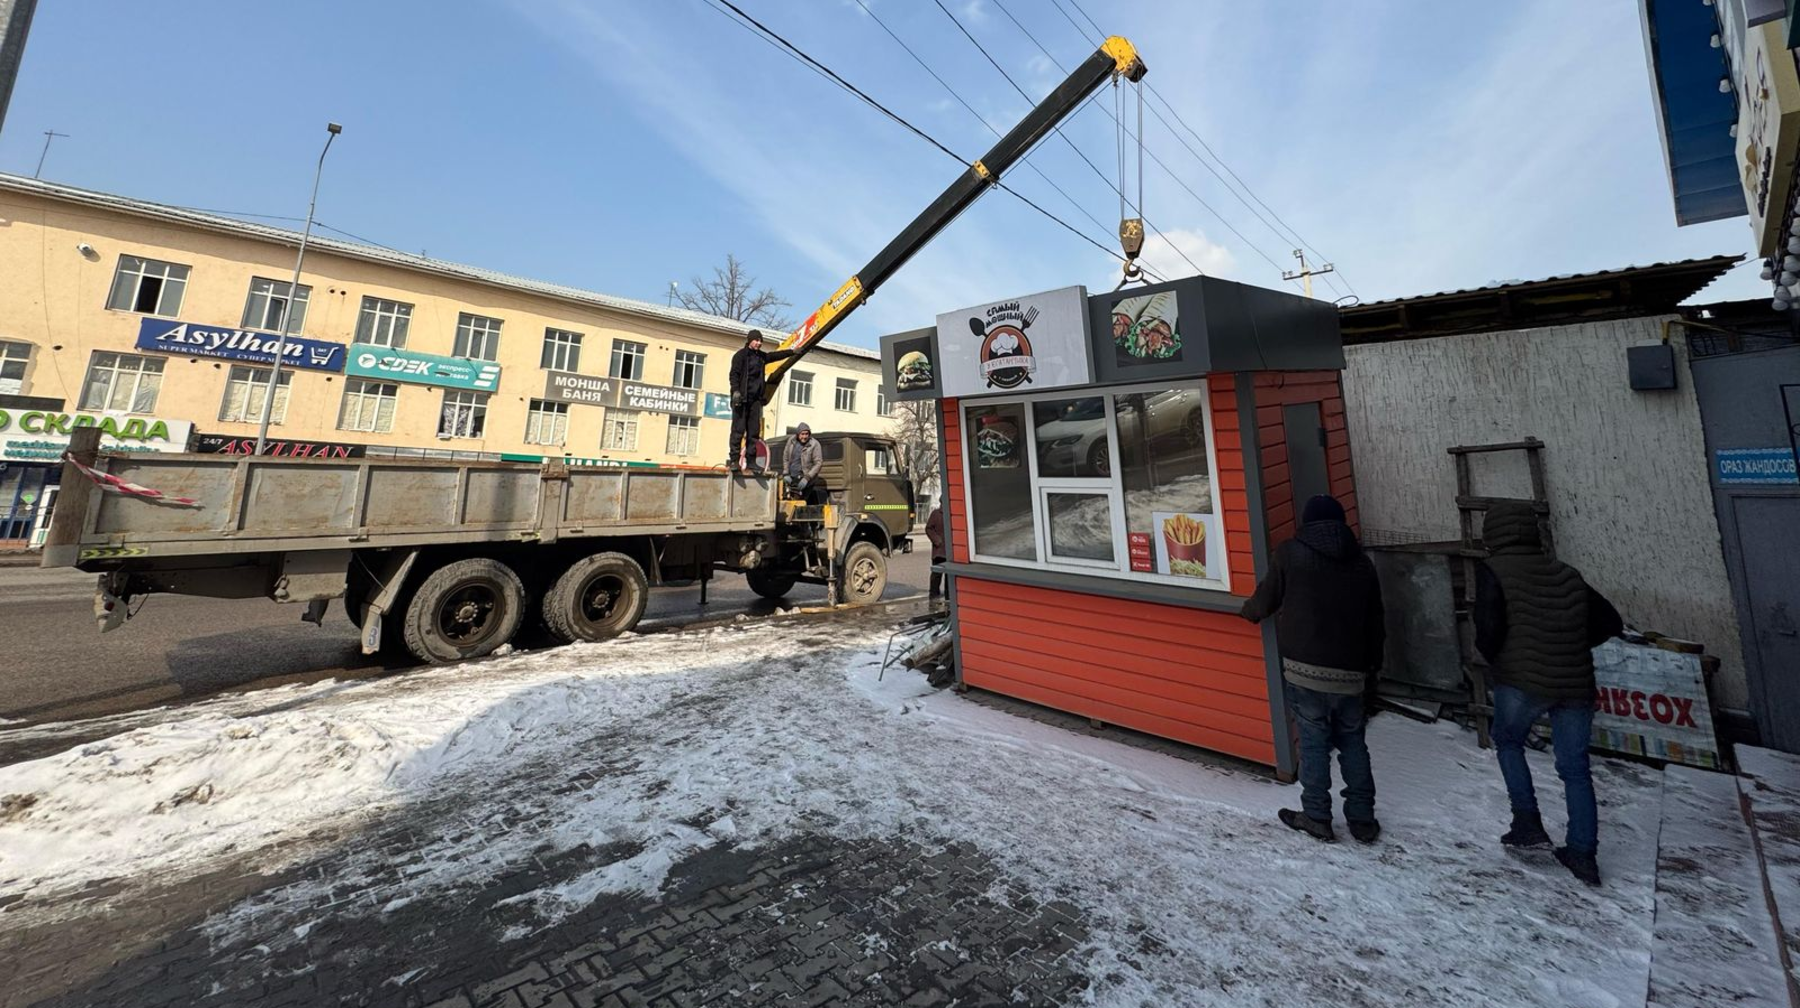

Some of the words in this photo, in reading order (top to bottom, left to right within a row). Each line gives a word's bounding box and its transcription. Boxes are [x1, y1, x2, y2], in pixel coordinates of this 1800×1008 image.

[156, 323, 304, 357] Asylhan
[378, 357, 435, 376] CDEK
[555, 376, 610, 392] МОНША
[562, 388, 601, 401] БАНЯ
[624, 385, 696, 403] СЕМЕЙНЫЕ
[629, 396, 688, 412] КАБИНКИ
[19, 411, 170, 442] СКЛАДА
[1720, 460, 1744, 474] ОРАЗ
[1744, 459, 1797, 475] ЖАНДОСОВ
